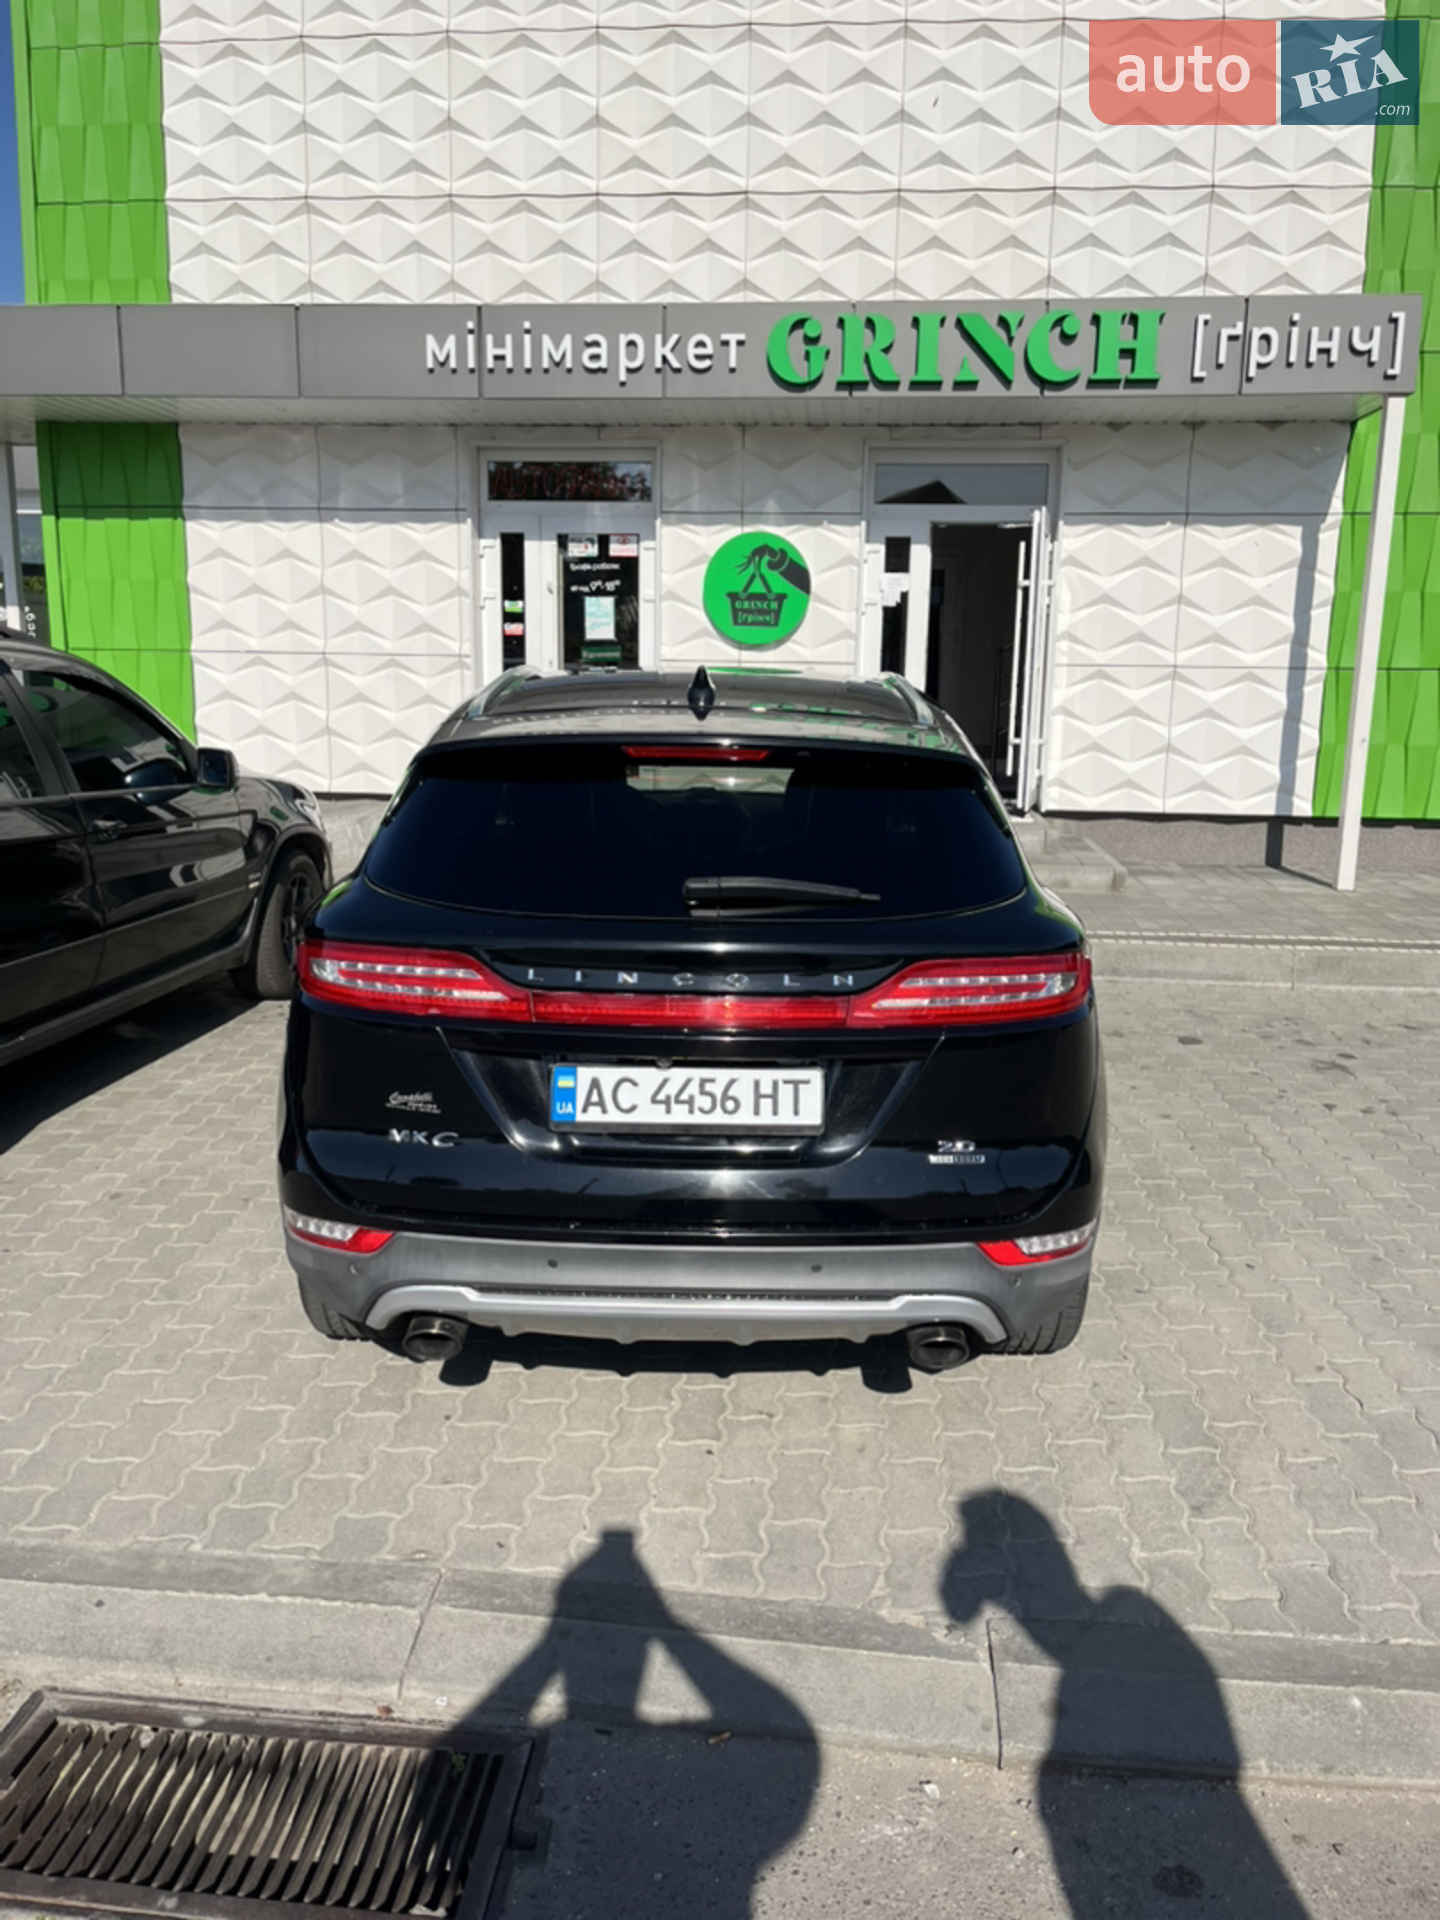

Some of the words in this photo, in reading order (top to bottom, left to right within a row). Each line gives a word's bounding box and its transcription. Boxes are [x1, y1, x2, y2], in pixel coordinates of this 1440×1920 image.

[425, 320, 746, 384] мінімаркет
[766, 308, 1166, 389] GRINCH
[735, 600, 778, 609] GRINCH
[527, 968, 854, 988] LINCOLN
[581, 1076, 640, 1115] AC
[650, 1077, 742, 1116] 4456
[753, 1078, 811, 1116] HT
[556, 1102, 574, 1114] UA
[388, 1127, 460, 1148] MKC
